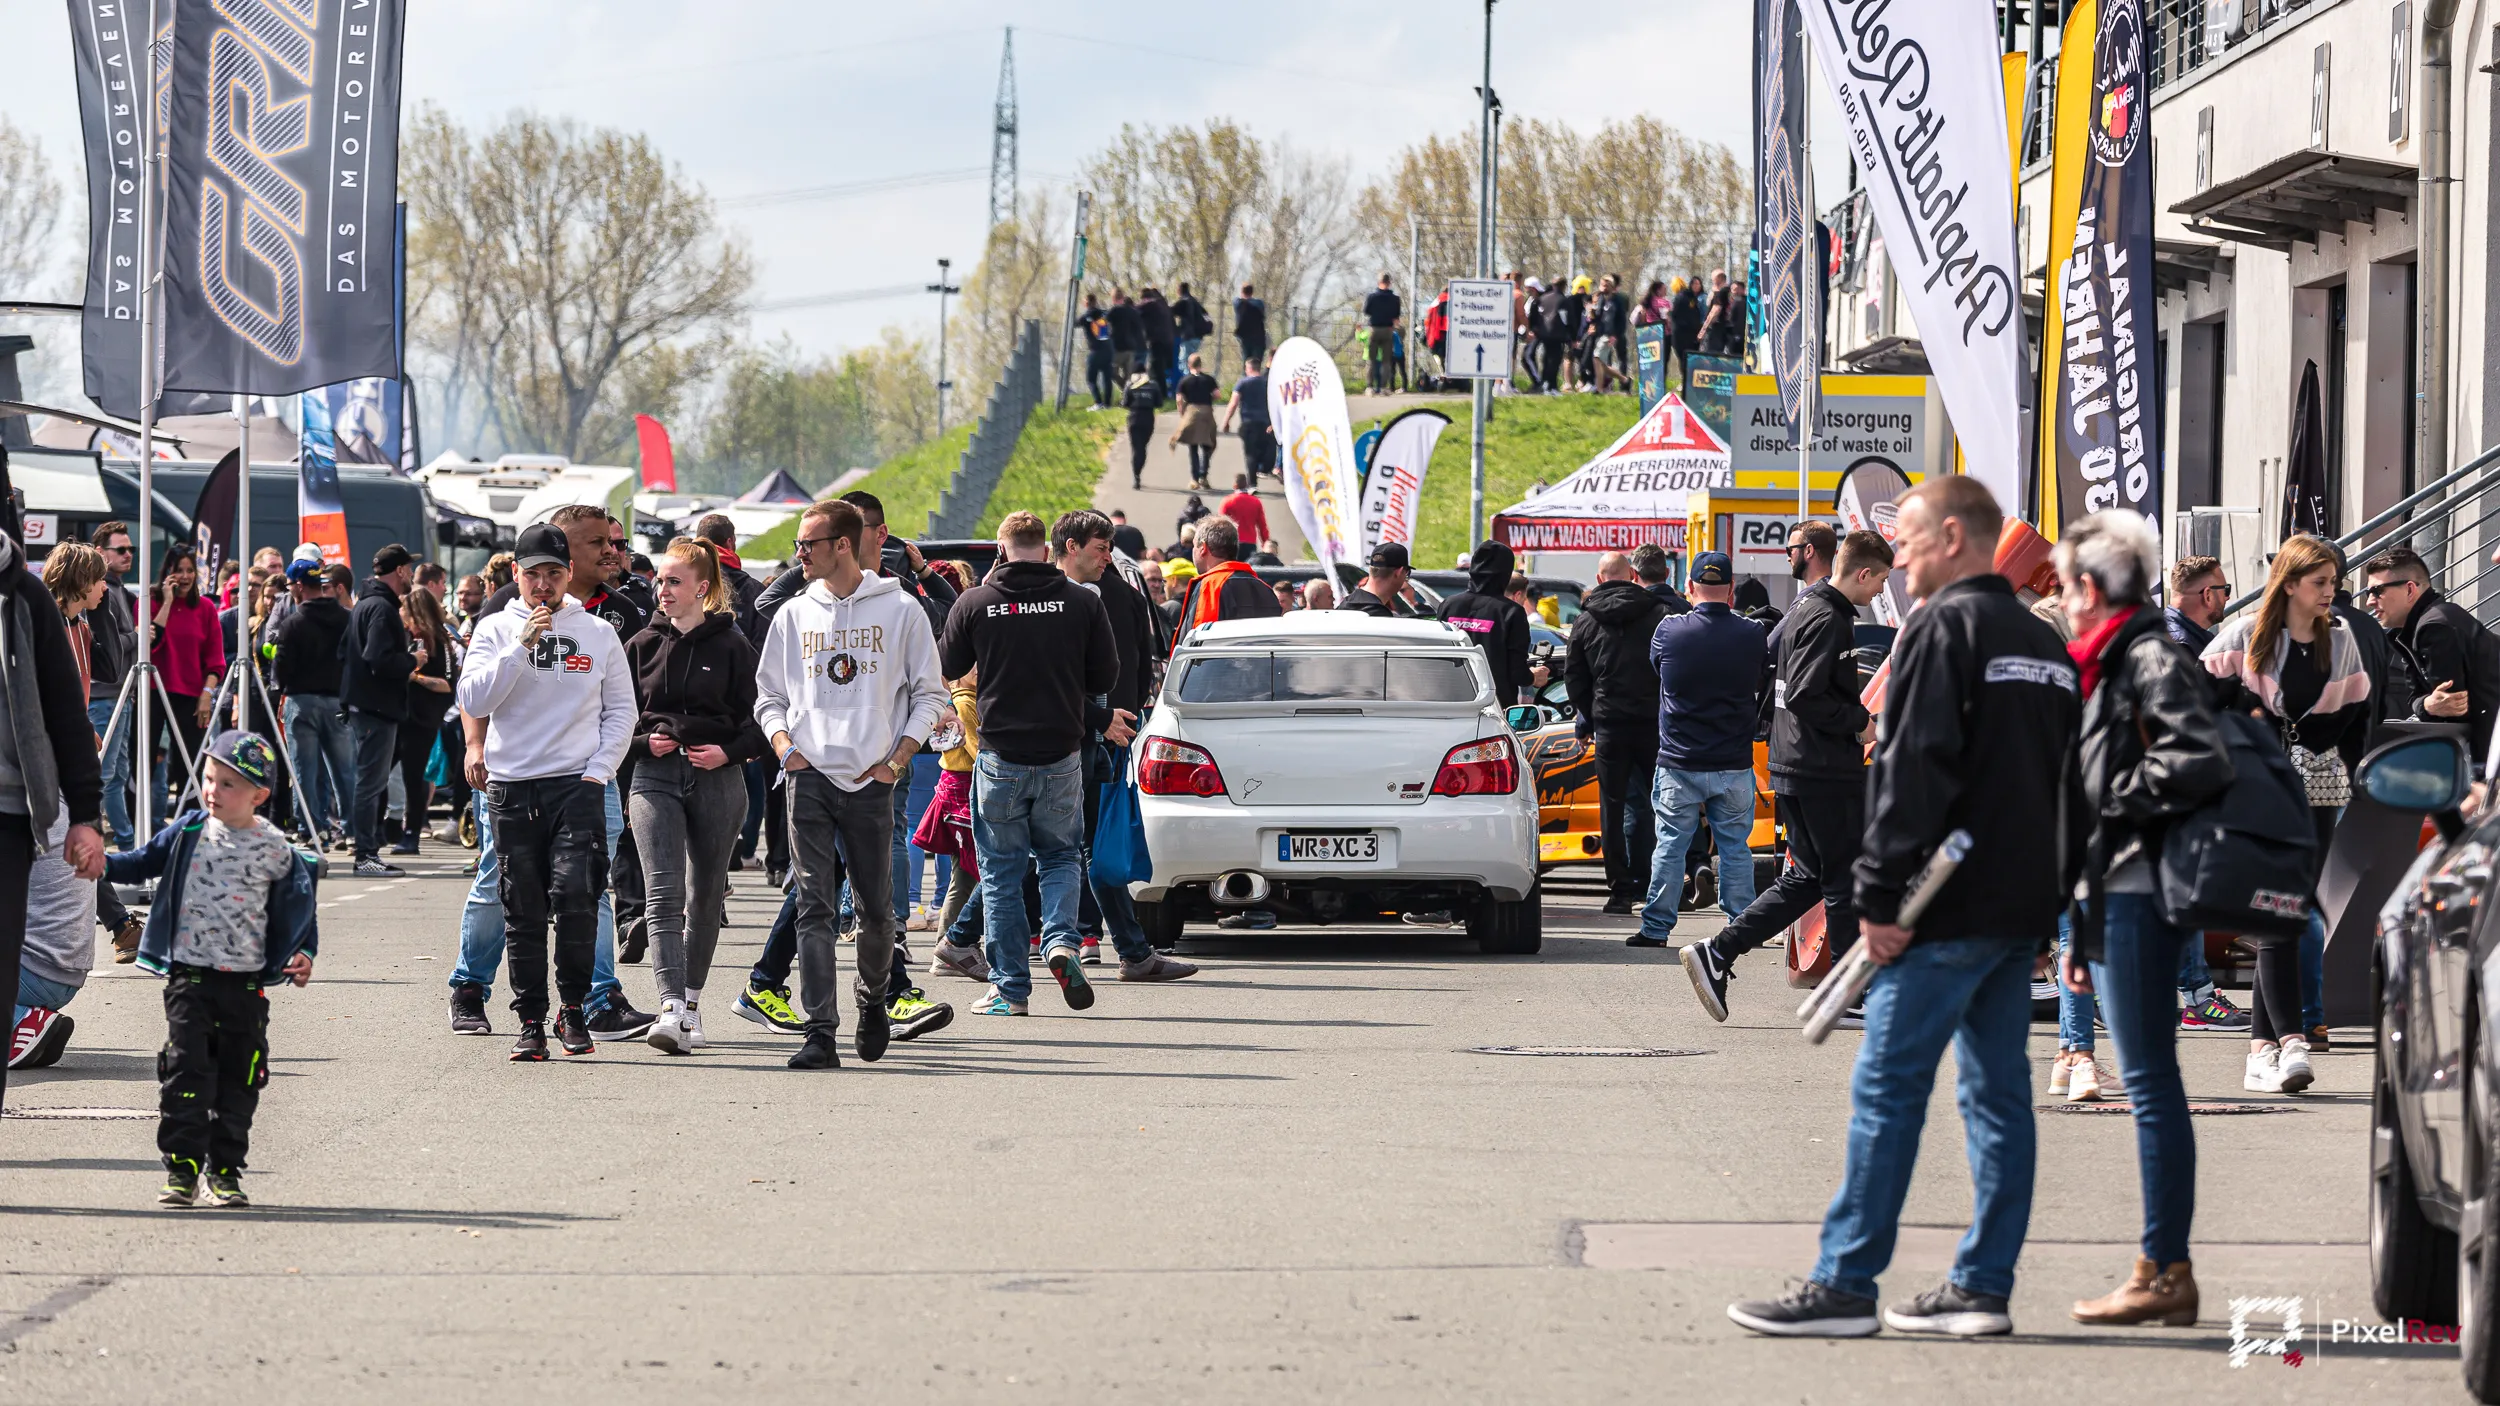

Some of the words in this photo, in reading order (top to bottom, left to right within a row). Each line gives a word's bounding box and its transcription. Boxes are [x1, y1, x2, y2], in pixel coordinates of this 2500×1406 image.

[2390, 29, 2405, 114] 21
[341, 0, 369, 189] MOTOREV
[2310, 70, 2323, 148] 22
[199, 0, 318, 367] GRI
[337, 222, 356, 293] DAS
[1642, 404, 1695, 445] #1
[1822, 436, 1838, 452] of
[1842, 438, 1888, 452] waste
[1893, 437, 1912, 453] oil
[1628, 458, 1729, 472] PERFORMANC
[1572, 471, 1732, 494] INTERCOOL
[1508, 524, 1688, 549] WWW.WAGNERTUNING
[986, 600, 1065, 618] E-EXHAUST
[801, 625, 885, 660] HILFIGER
[565, 654, 592, 672] 99
[808, 664, 823, 679] 19
[860, 660, 878, 675] 85
[1291, 837, 1318, 858] WR
[1332, 837, 1359, 858] XC
[1363, 837, 1376, 857] 3
